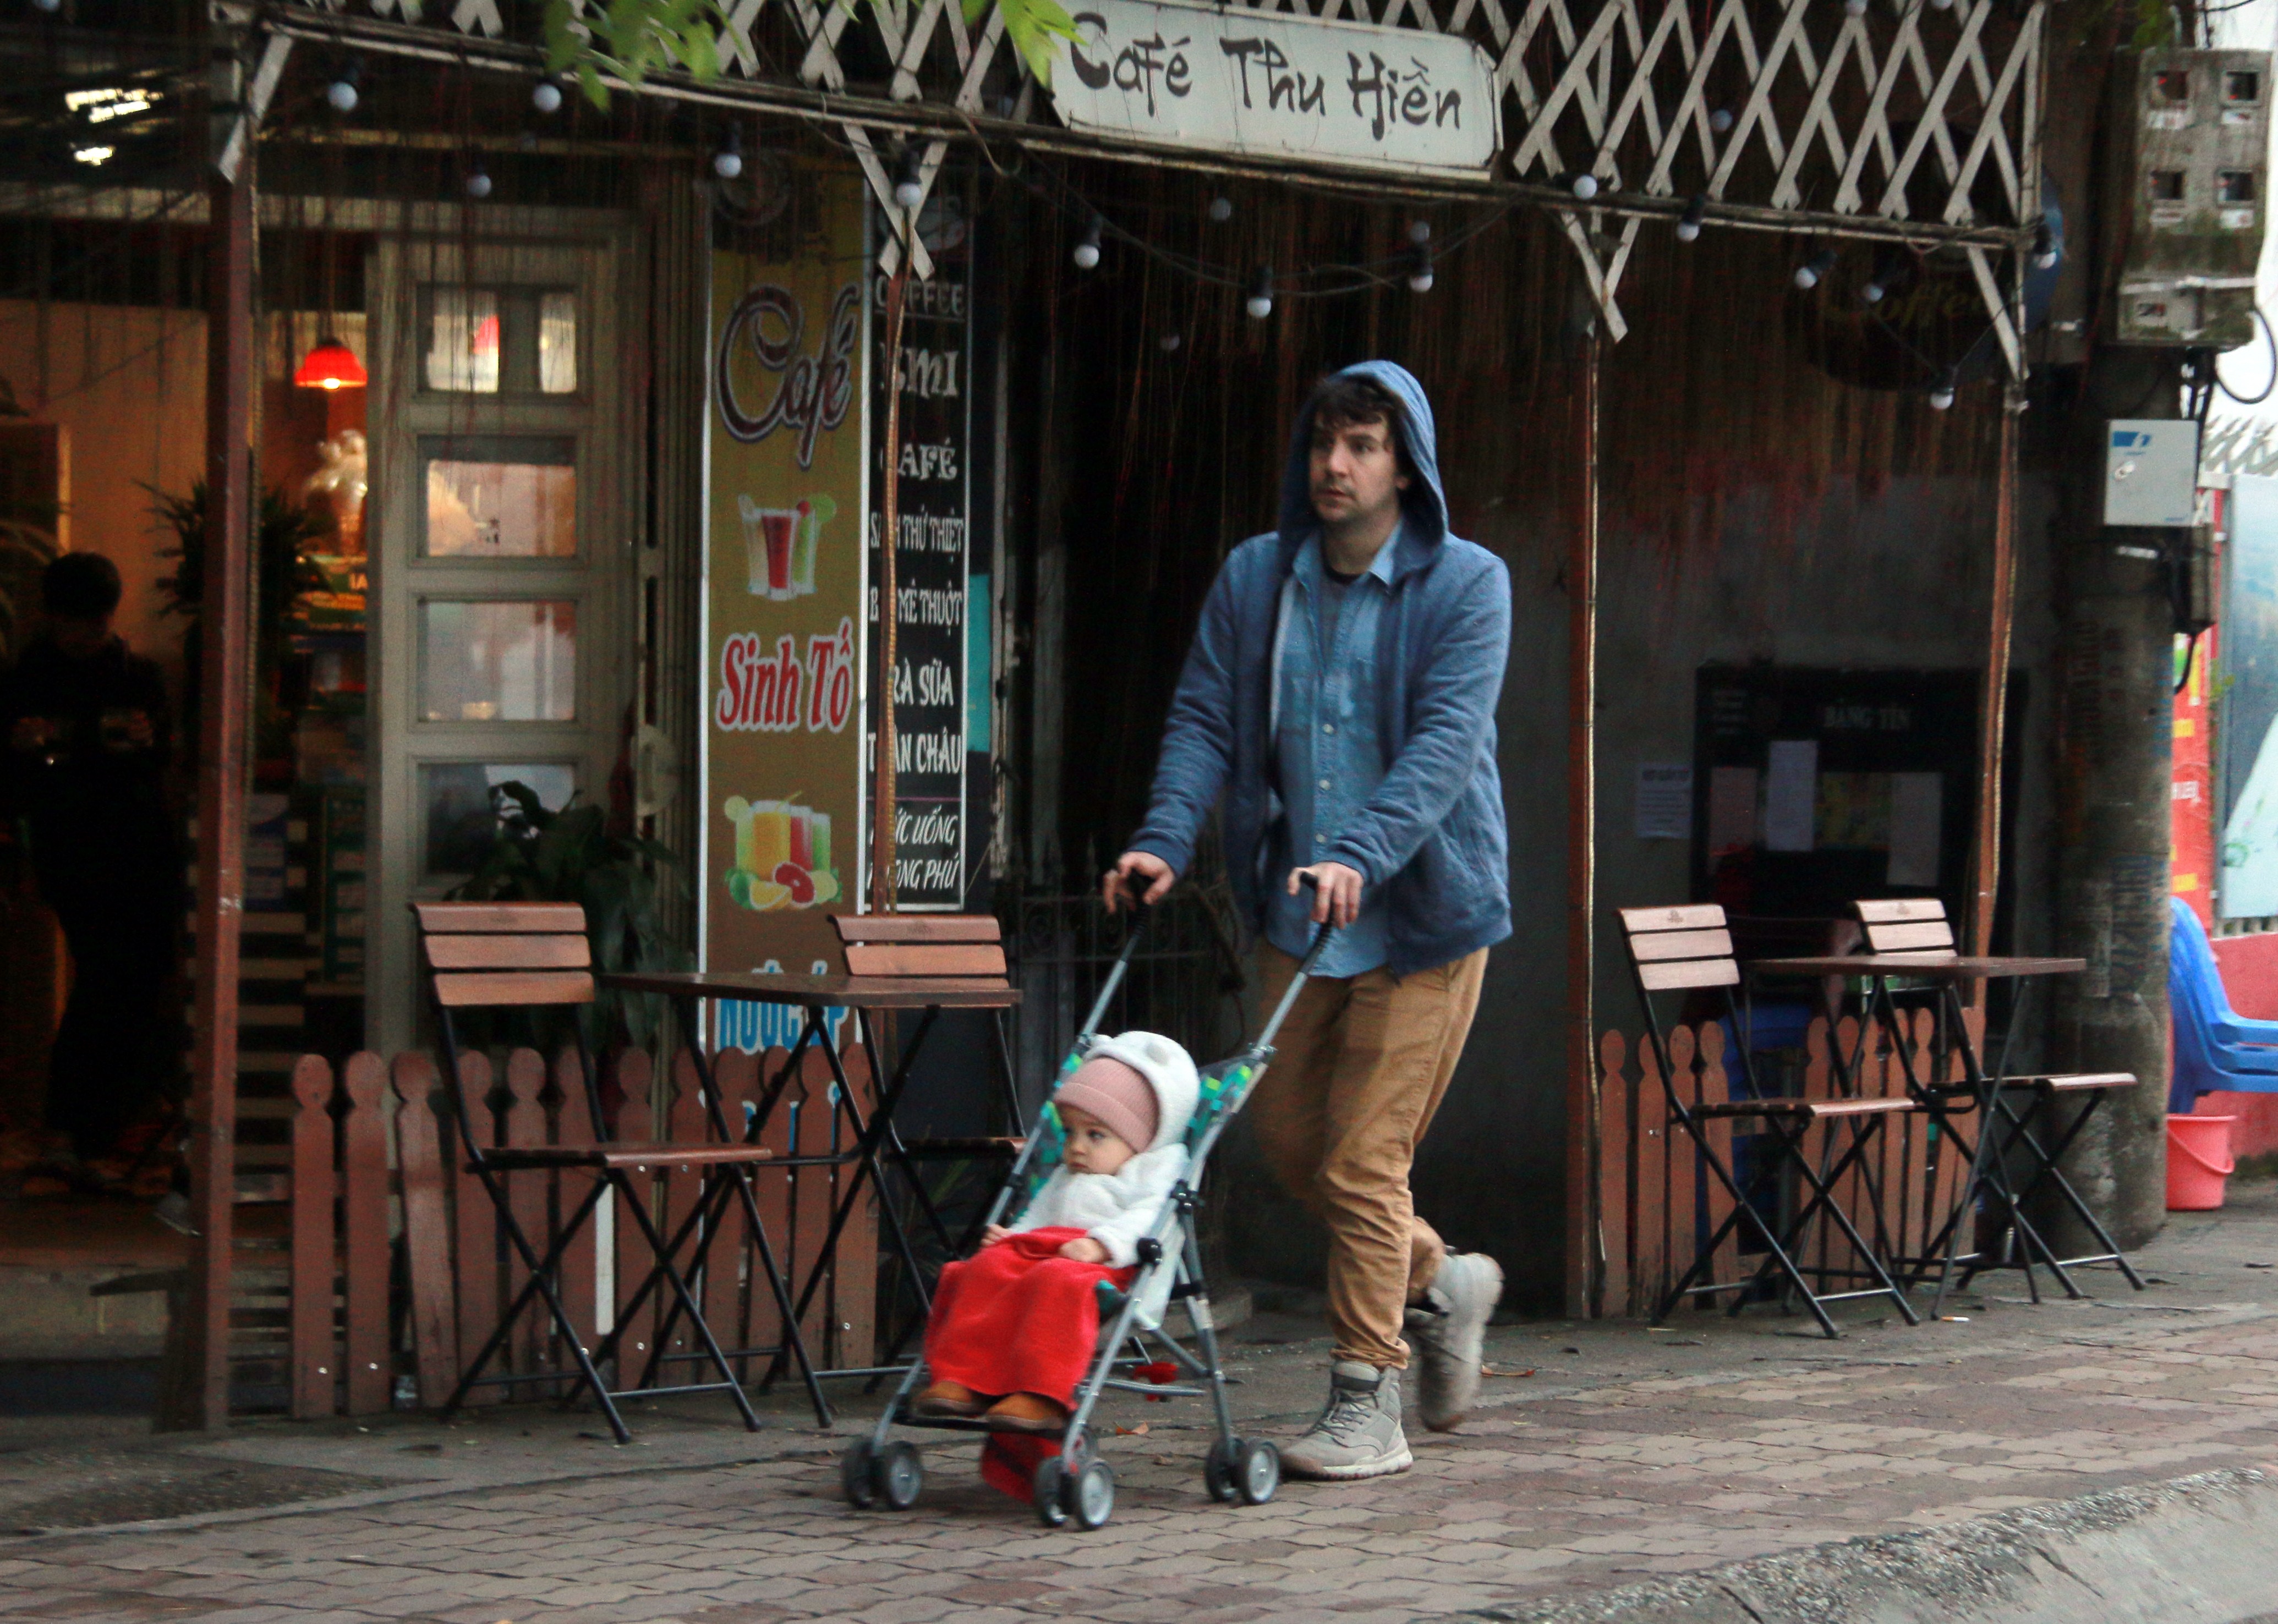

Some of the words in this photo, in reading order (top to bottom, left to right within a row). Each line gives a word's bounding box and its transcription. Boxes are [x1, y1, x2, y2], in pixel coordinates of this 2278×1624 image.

[1070, 12, 1192, 117] Café
[1219, 37, 1326, 116] Thu
[1348, 51, 1461, 141] Hiền
[875, 274, 964, 315] CFFEE
[718, 284, 859, 471] Café
[879, 437, 958, 480] AFÉ
[716, 632, 803, 731] Sinh
[807, 616, 854, 733] Tố
[892, 657, 914, 704] RÀ
[918, 657, 954, 706] SỮA
[916, 725, 962, 773] CHÂU
[911, 804, 959, 846] UỐNG
[922, 851, 960, 891] PHÚ
